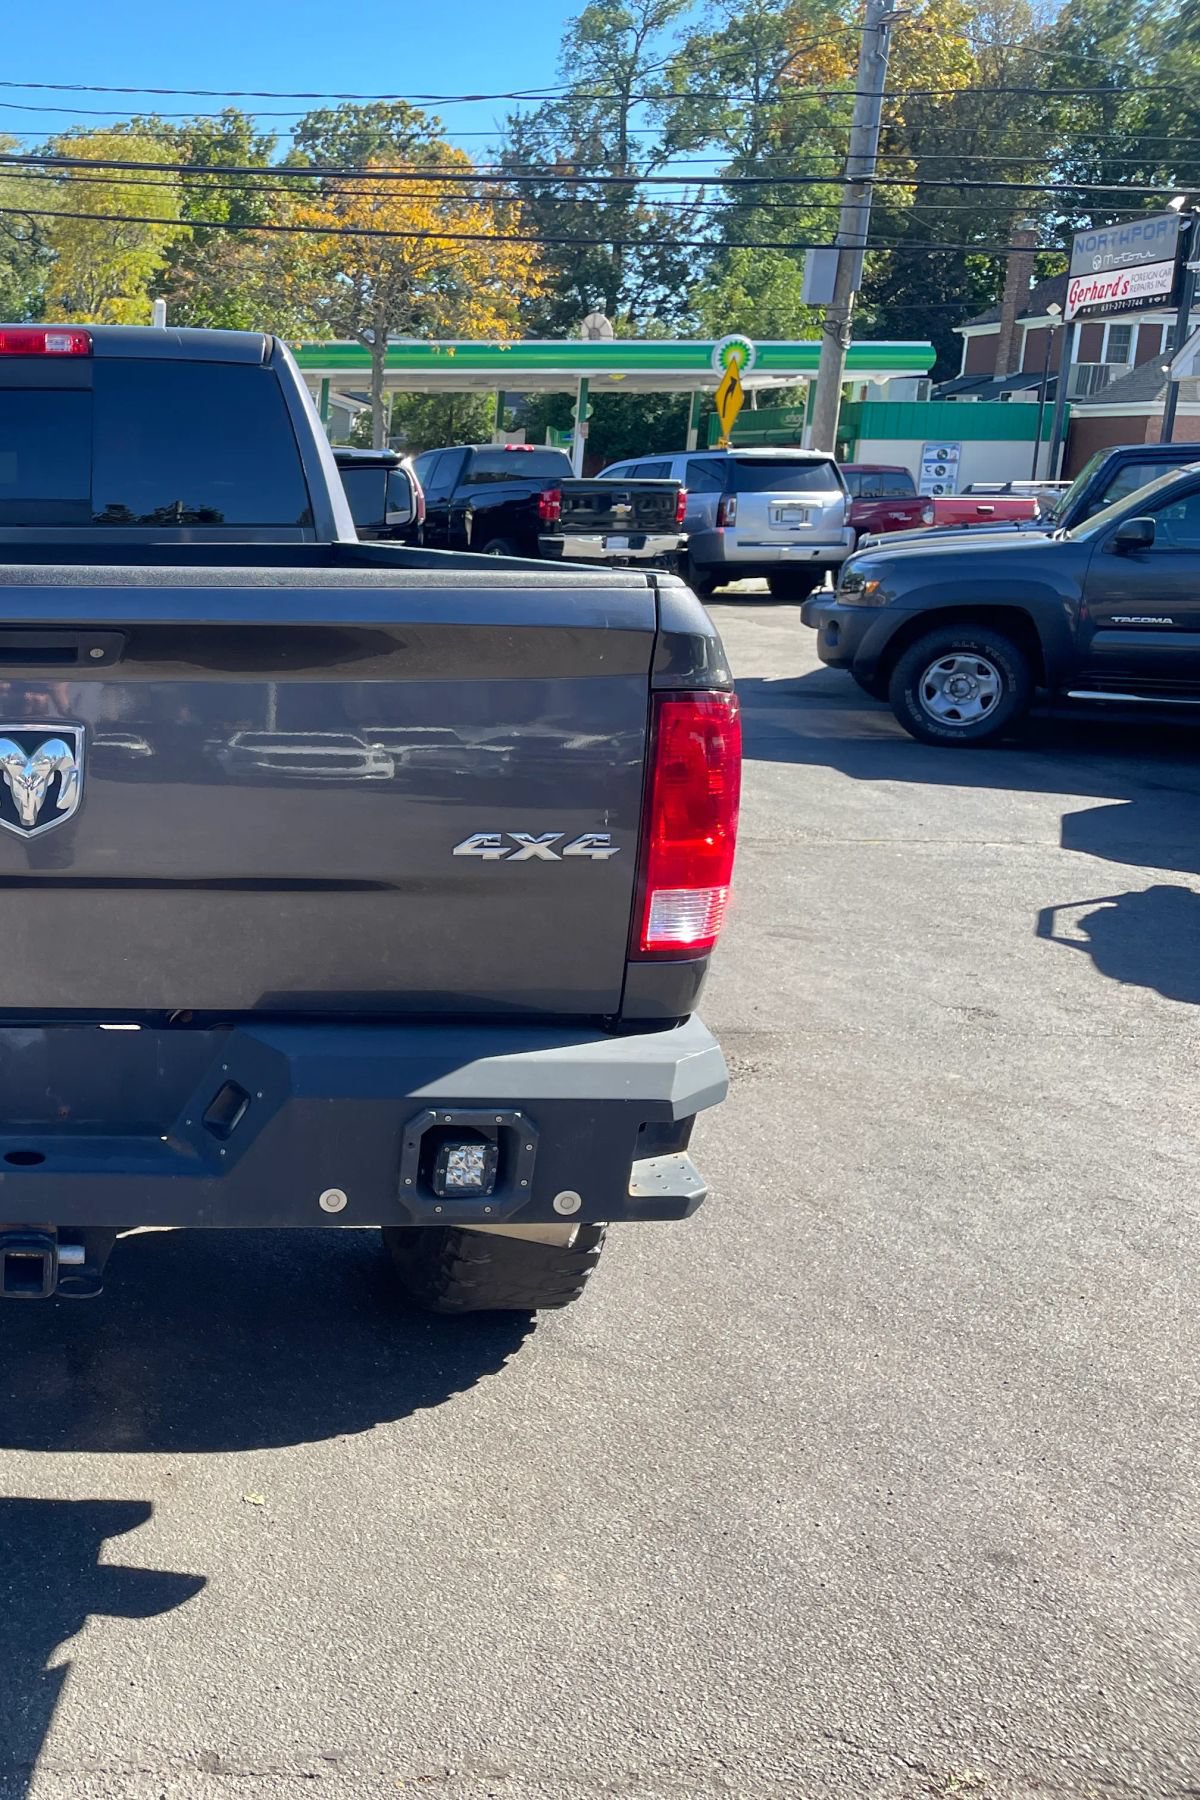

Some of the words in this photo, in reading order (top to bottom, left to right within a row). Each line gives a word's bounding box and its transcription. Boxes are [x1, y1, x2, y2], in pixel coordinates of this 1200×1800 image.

[1075, 220, 1178, 254] NORTHPORT
[1069, 274, 1130, 312] Gerhard's
[1111, 616, 1173, 624] TACOMA
[452, 832, 621, 861] 4X4
